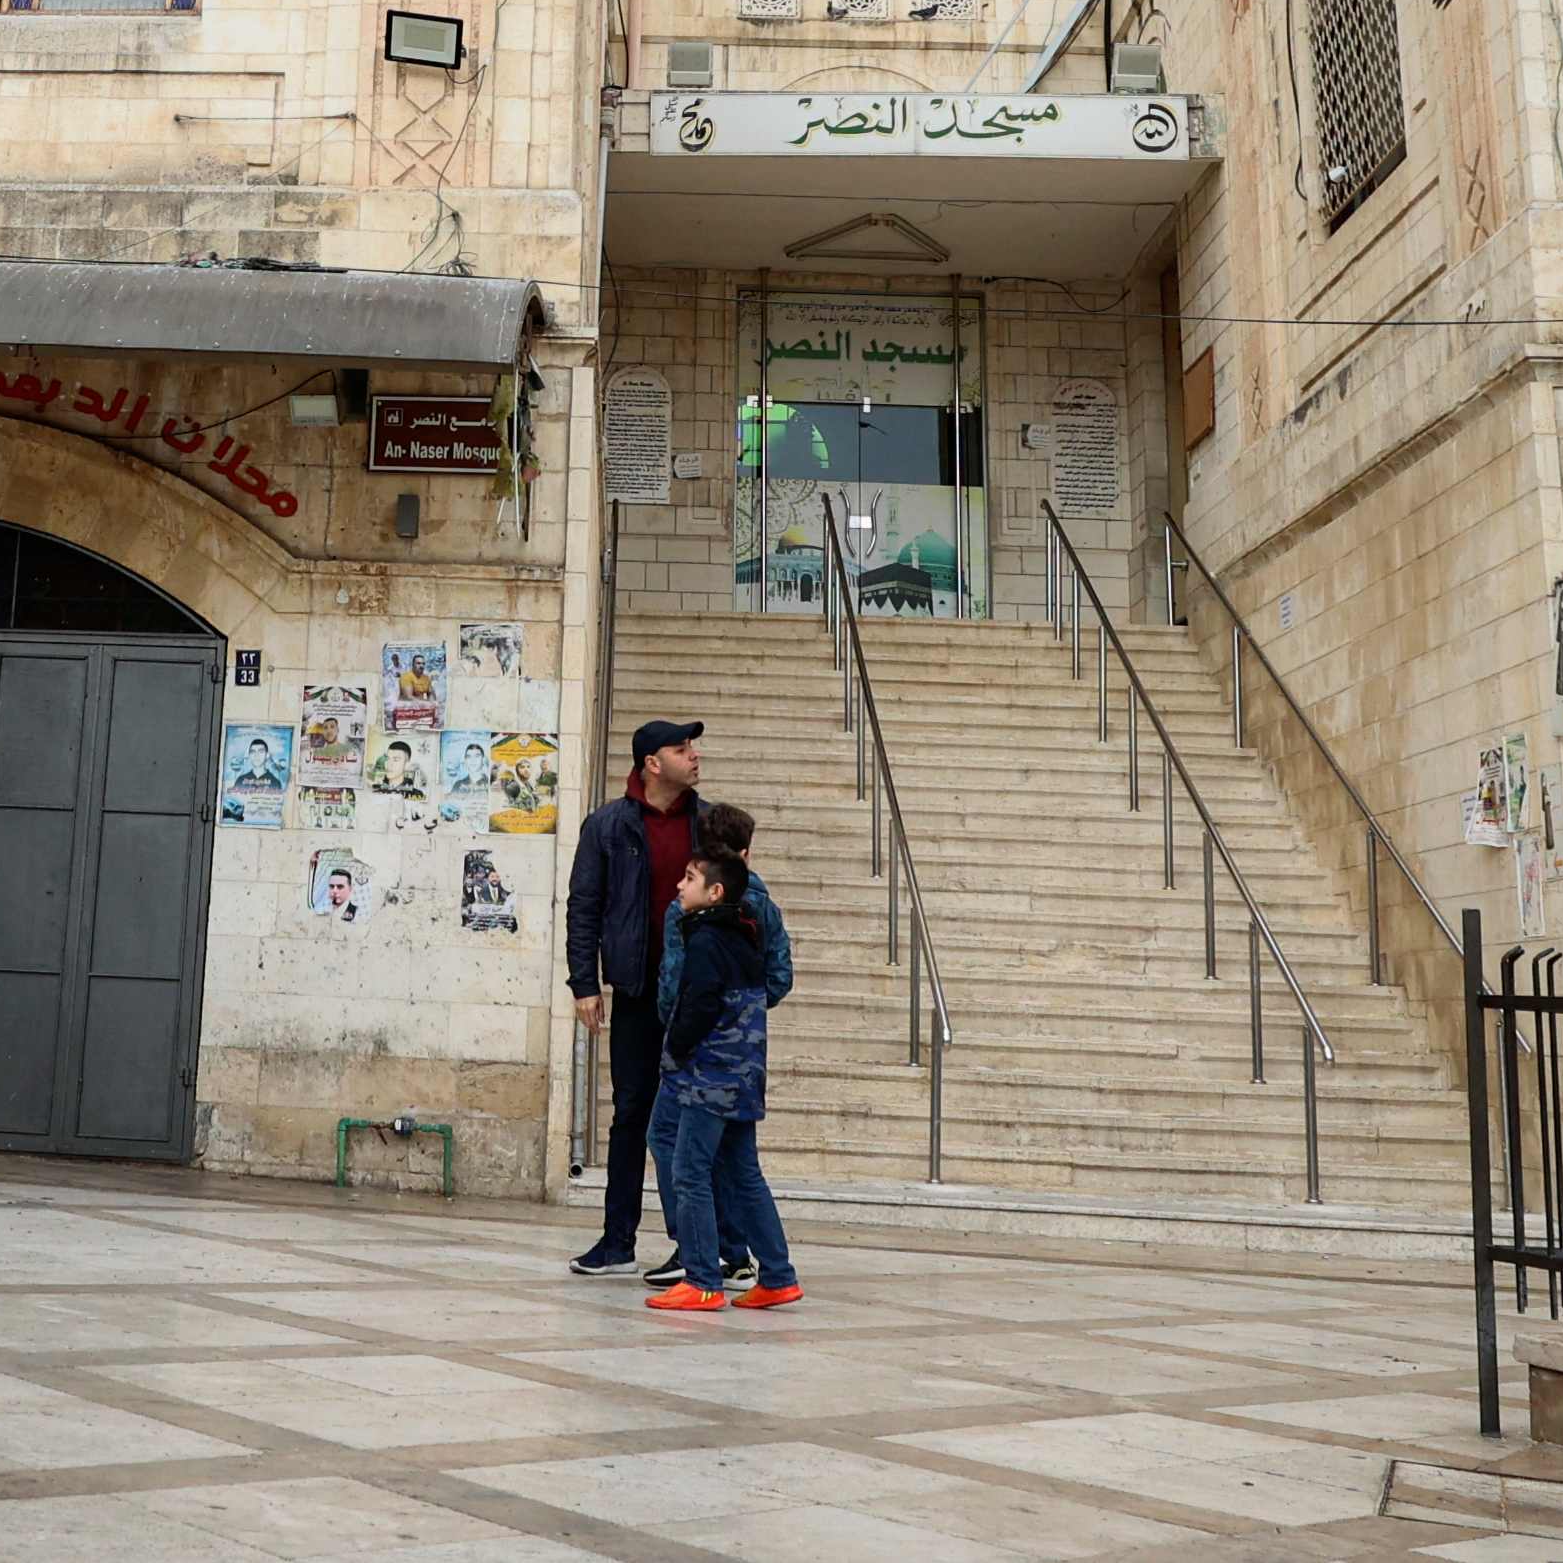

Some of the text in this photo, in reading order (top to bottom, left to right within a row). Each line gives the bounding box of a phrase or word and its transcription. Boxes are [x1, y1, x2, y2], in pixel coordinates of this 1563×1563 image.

[787, 97, 909, 145] النصر
[753, 329, 968, 373] مسجد النصر
[409, 412, 447, 428] النصر
[384, 440, 407, 458] An-
[410, 441, 450, 459] Naser
[161, 416, 298, 518] محلات
[240, 670, 255, 683] 33
